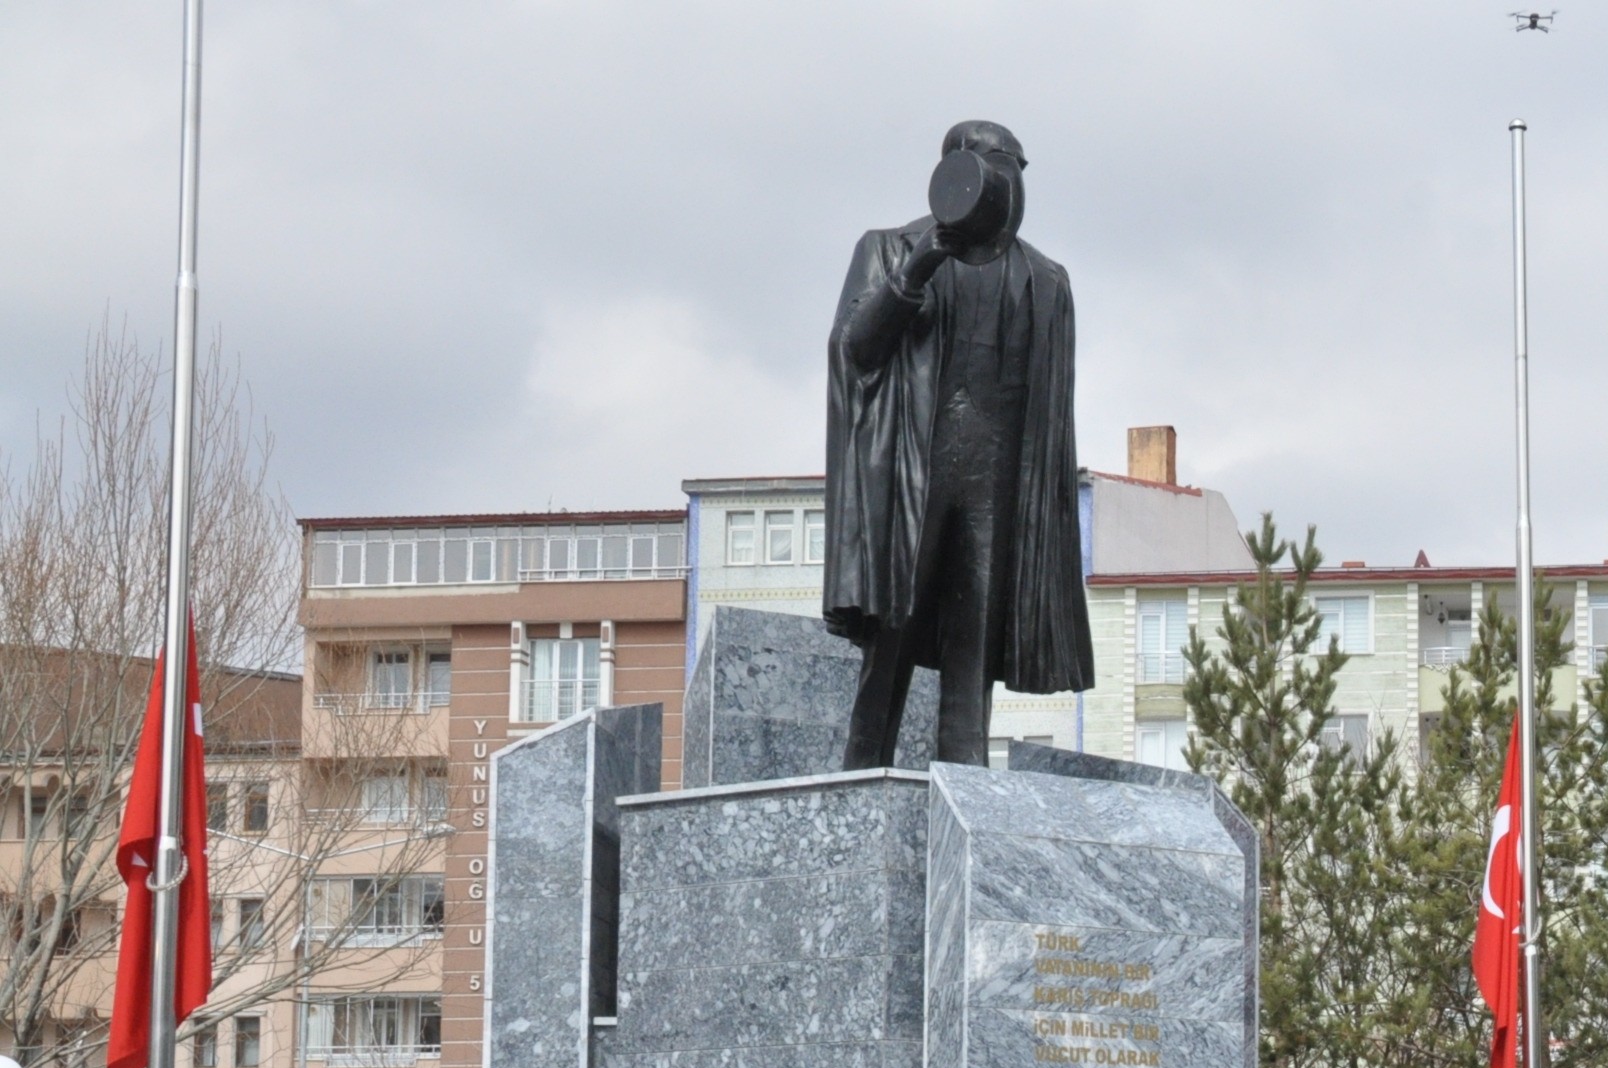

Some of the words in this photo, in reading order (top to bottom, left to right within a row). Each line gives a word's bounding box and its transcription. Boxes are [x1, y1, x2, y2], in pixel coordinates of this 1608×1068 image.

[471, 718, 487, 828] YUNUS
[1035, 931, 1082, 952] TÜRK
[469, 975, 481, 991] 5
[1090, 990, 1158, 1010] TOPRAĞI
[1034, 1018, 1066, 1038] İÇİN
[1071, 1020, 1129, 1039] MİLLET
[1035, 1045, 1091, 1064] VÜCUT
[1095, 1047, 1160, 1067] OLARAK
